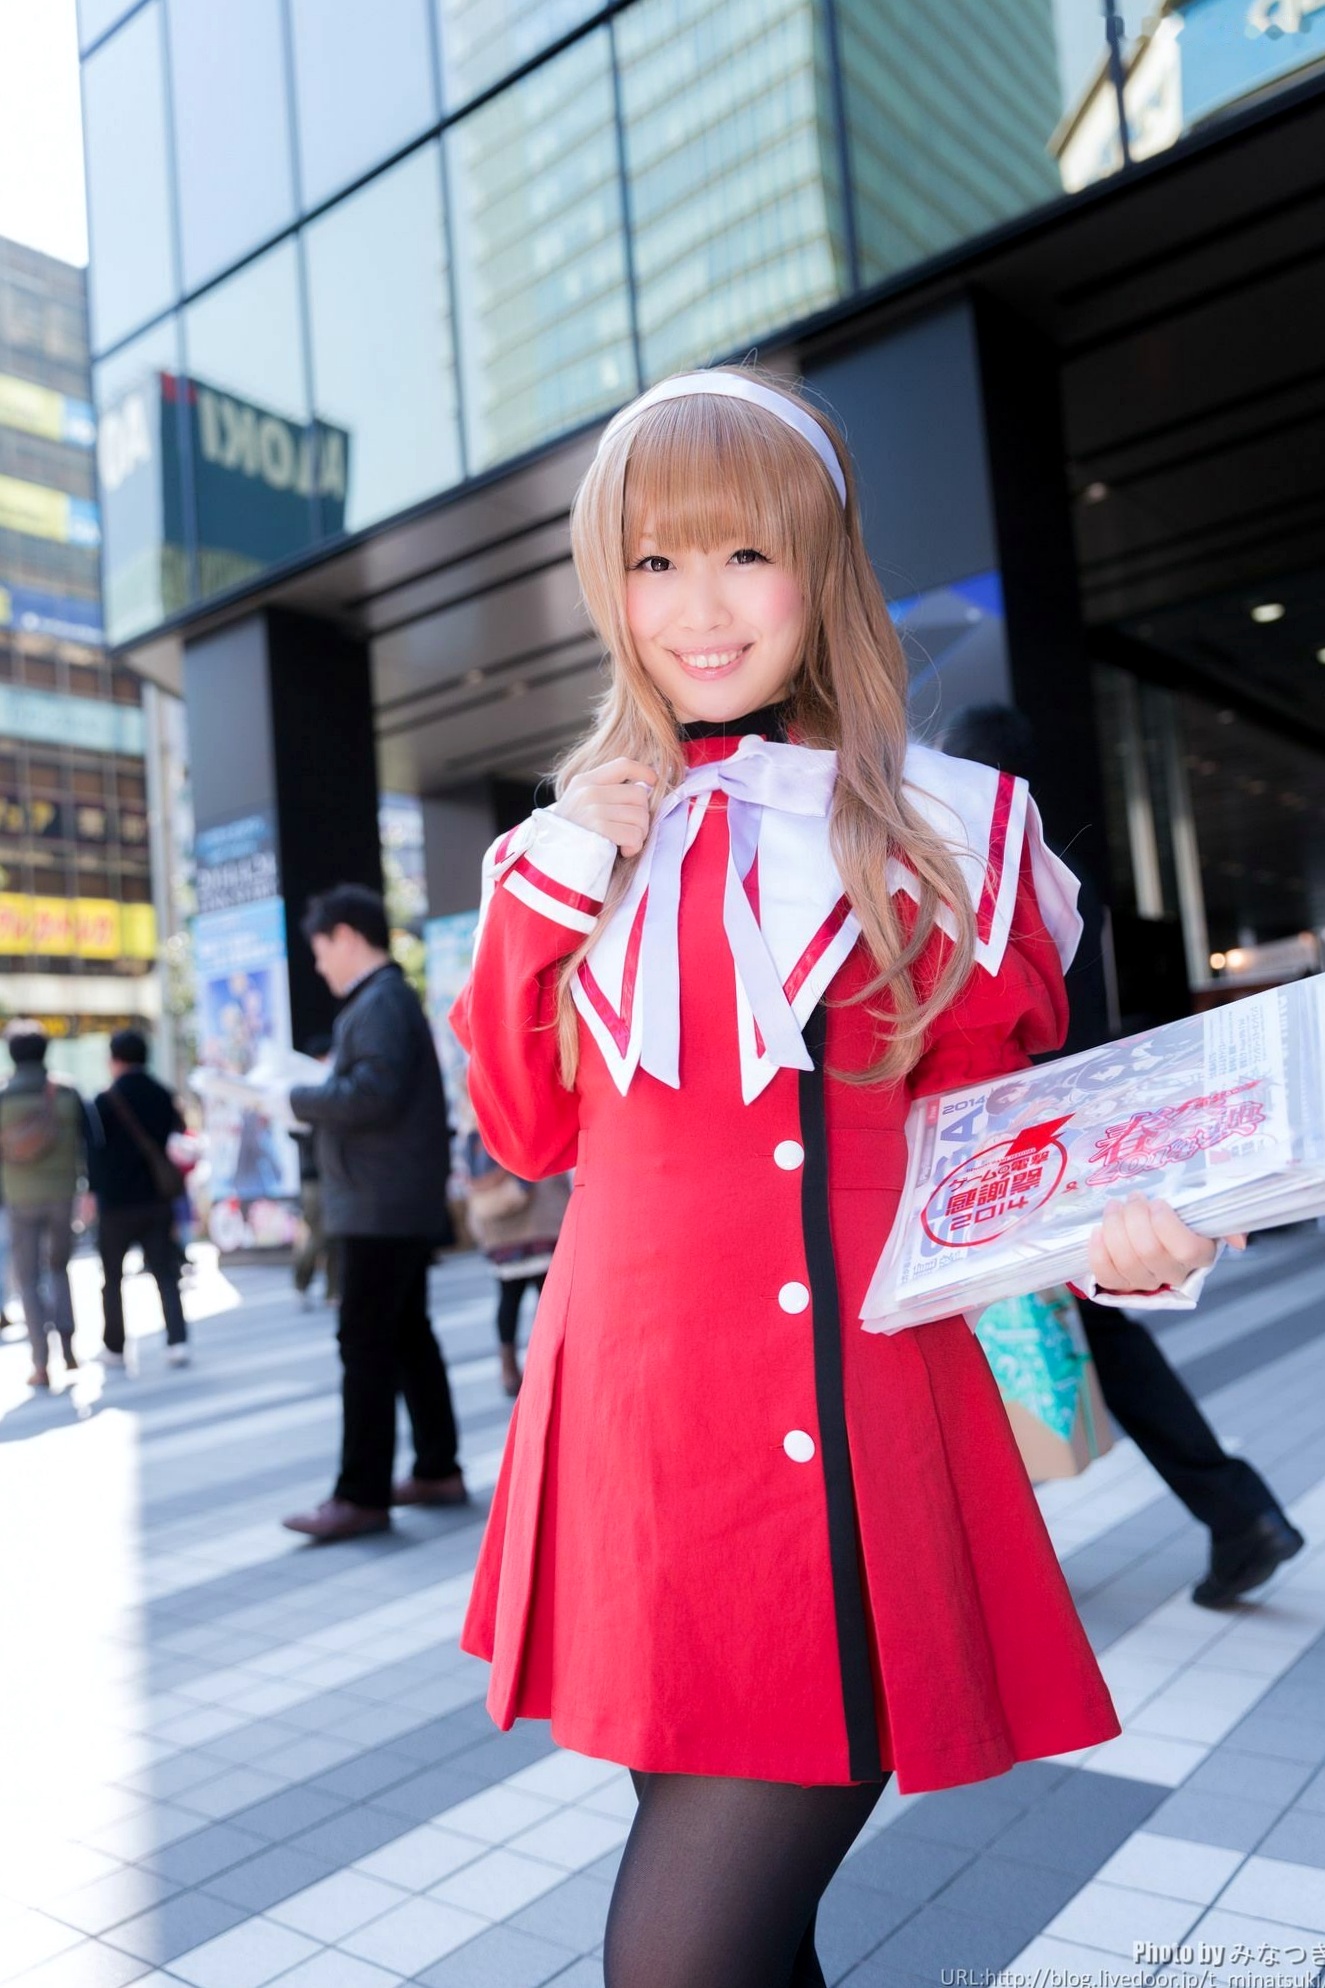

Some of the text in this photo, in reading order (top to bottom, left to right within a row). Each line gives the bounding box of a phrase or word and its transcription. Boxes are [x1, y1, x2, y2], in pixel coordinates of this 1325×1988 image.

[942, 1094, 986, 1115] 2014
[945, 1166, 1043, 1217] 感謝祭
[950, 1195, 1029, 1232] 2014
